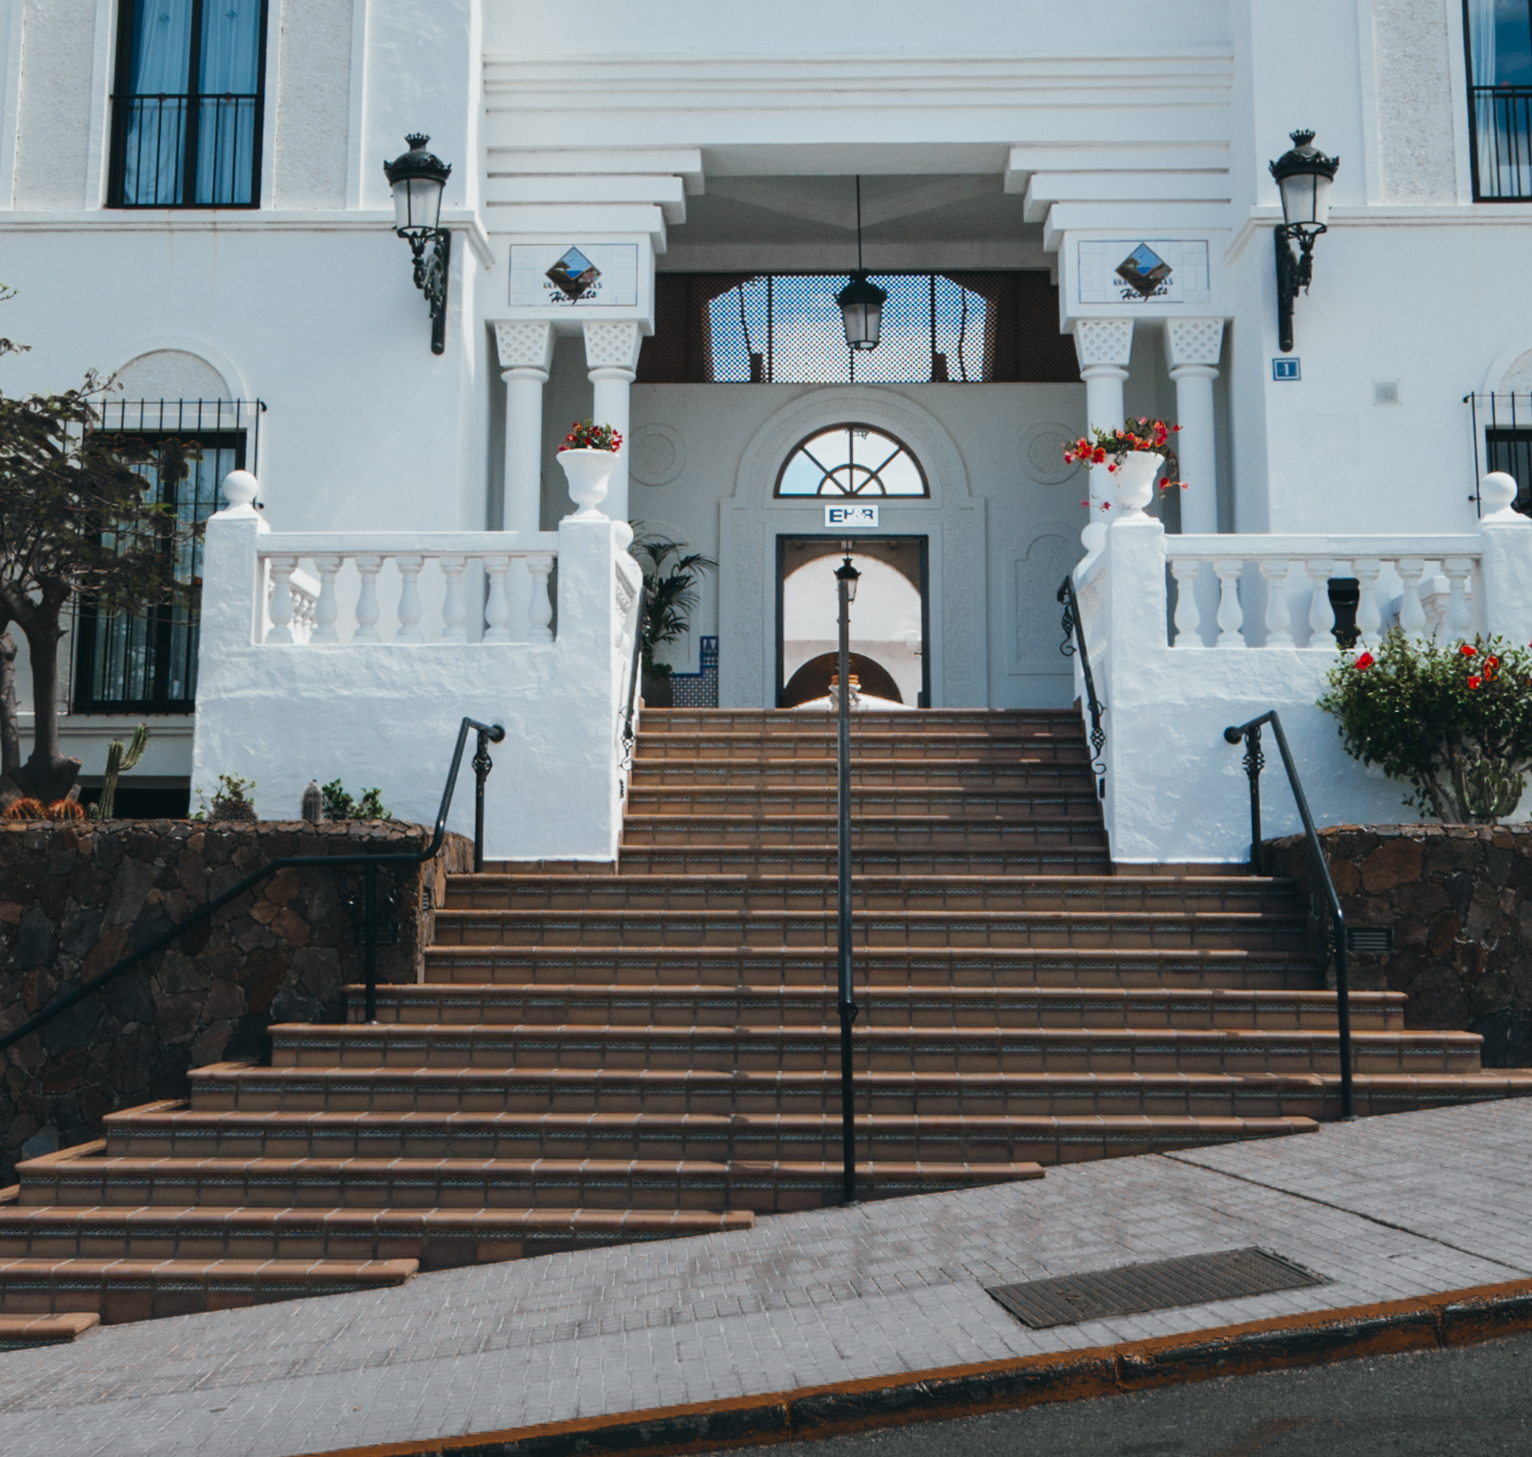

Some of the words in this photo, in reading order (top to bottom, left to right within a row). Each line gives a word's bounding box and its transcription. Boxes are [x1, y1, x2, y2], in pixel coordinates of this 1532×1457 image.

[549, 290, 597, 306] Heits
[1120, 287, 1168, 303] Heits
[829, 509, 874, 523] EHR
